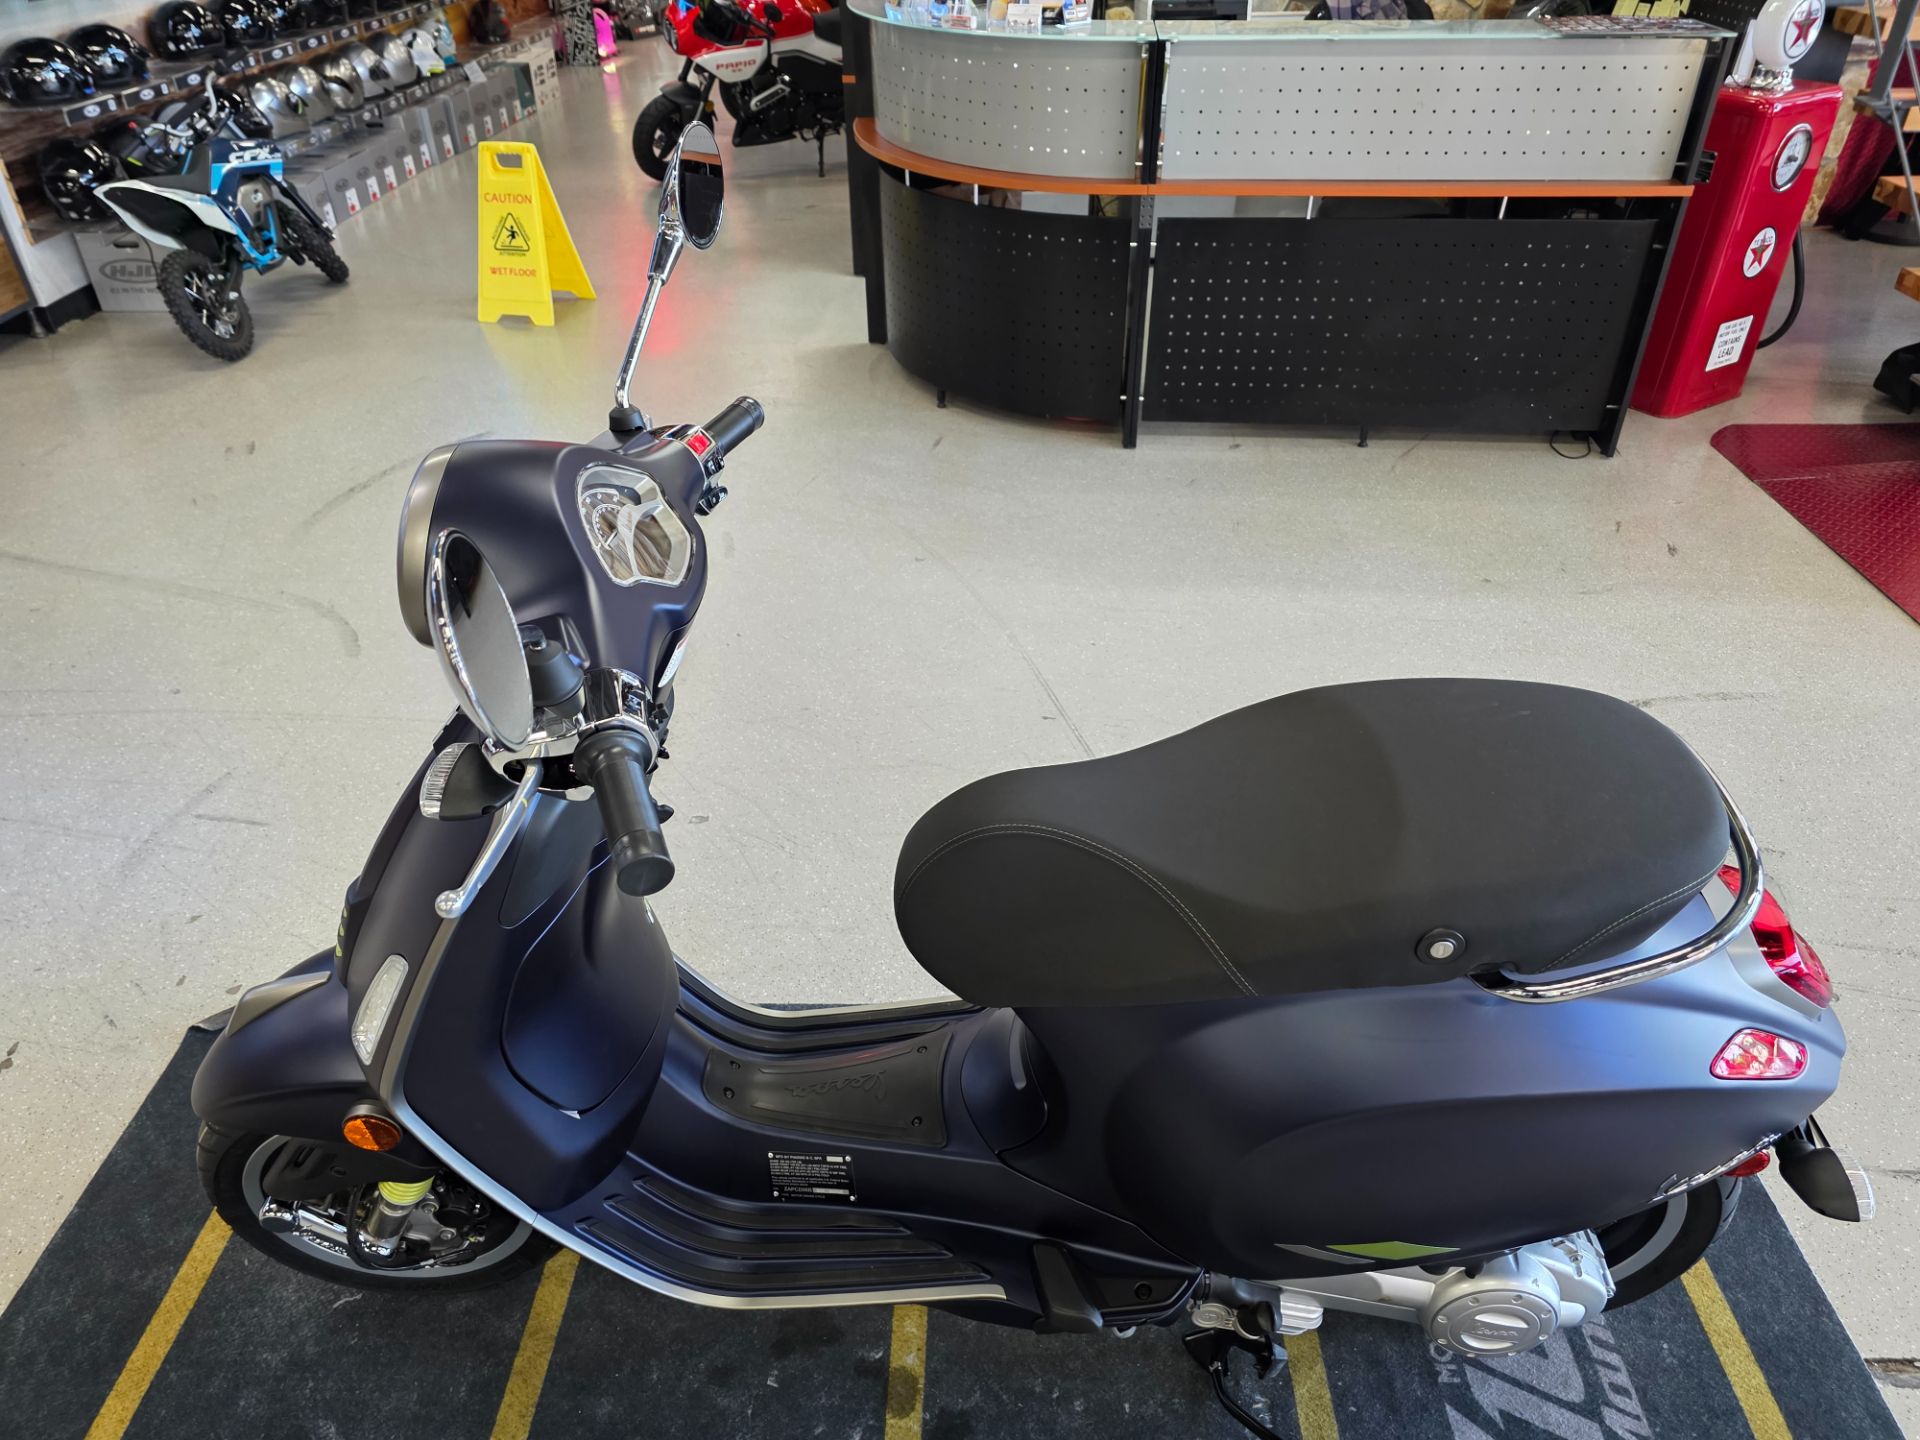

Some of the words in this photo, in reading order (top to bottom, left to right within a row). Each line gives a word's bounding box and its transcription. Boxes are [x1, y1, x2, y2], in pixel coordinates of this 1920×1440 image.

[483, 192, 533, 205] CAUTION
[489, 266, 507, 276] WET
[508, 267, 537, 278] FLOOR
[1717, 335, 1741, 347] CONTAINS
[1717, 346, 1734, 358] LEAD
